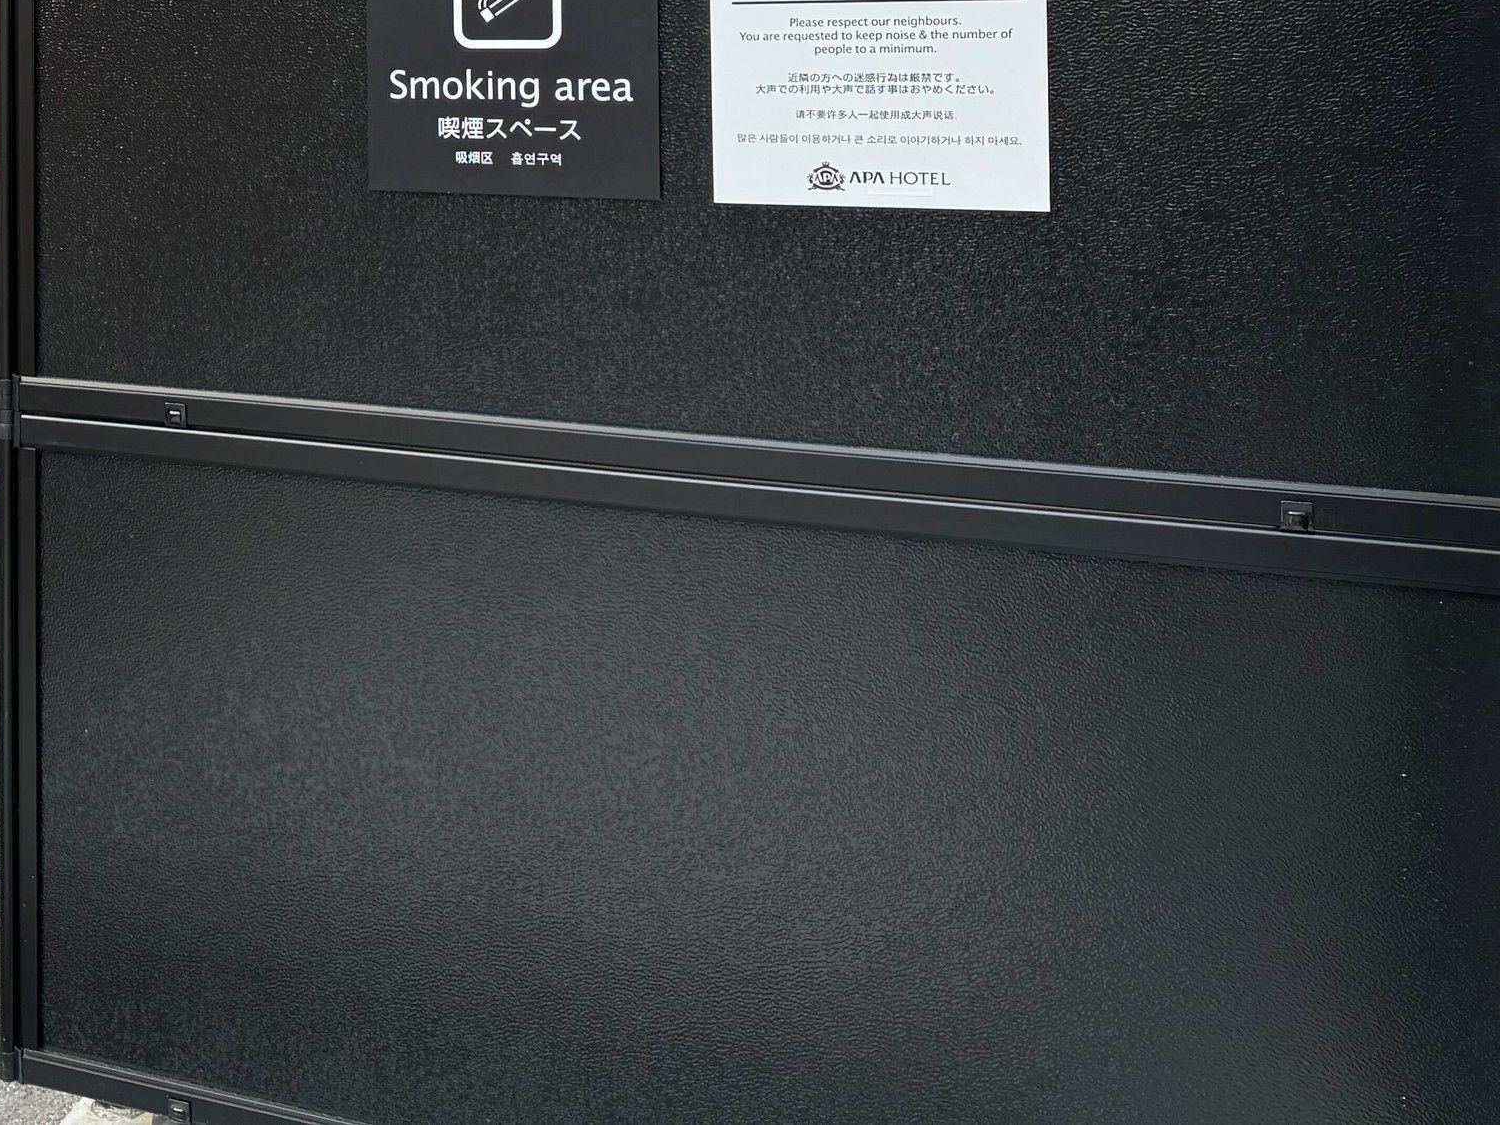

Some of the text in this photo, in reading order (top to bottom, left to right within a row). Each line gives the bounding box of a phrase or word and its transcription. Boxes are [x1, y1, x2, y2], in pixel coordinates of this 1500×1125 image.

[789, 16, 962, 29] Please respect our neighbours.
[739, 28, 1013, 43] You are requested to keep noise & the number of
[814, 43, 937, 56] people to a minimum.
[389, 68, 635, 108] Smoking area
[437, 116, 582, 141] 喫煙スペース
[801, 134, 851, 144] 이용하거나
[866, 135, 898, 145] 소리로
[455, 151, 494, 165] 吸烟区
[510, 151, 563, 166] 흡연구역
[849, 171, 951, 186] APA HOTEL
